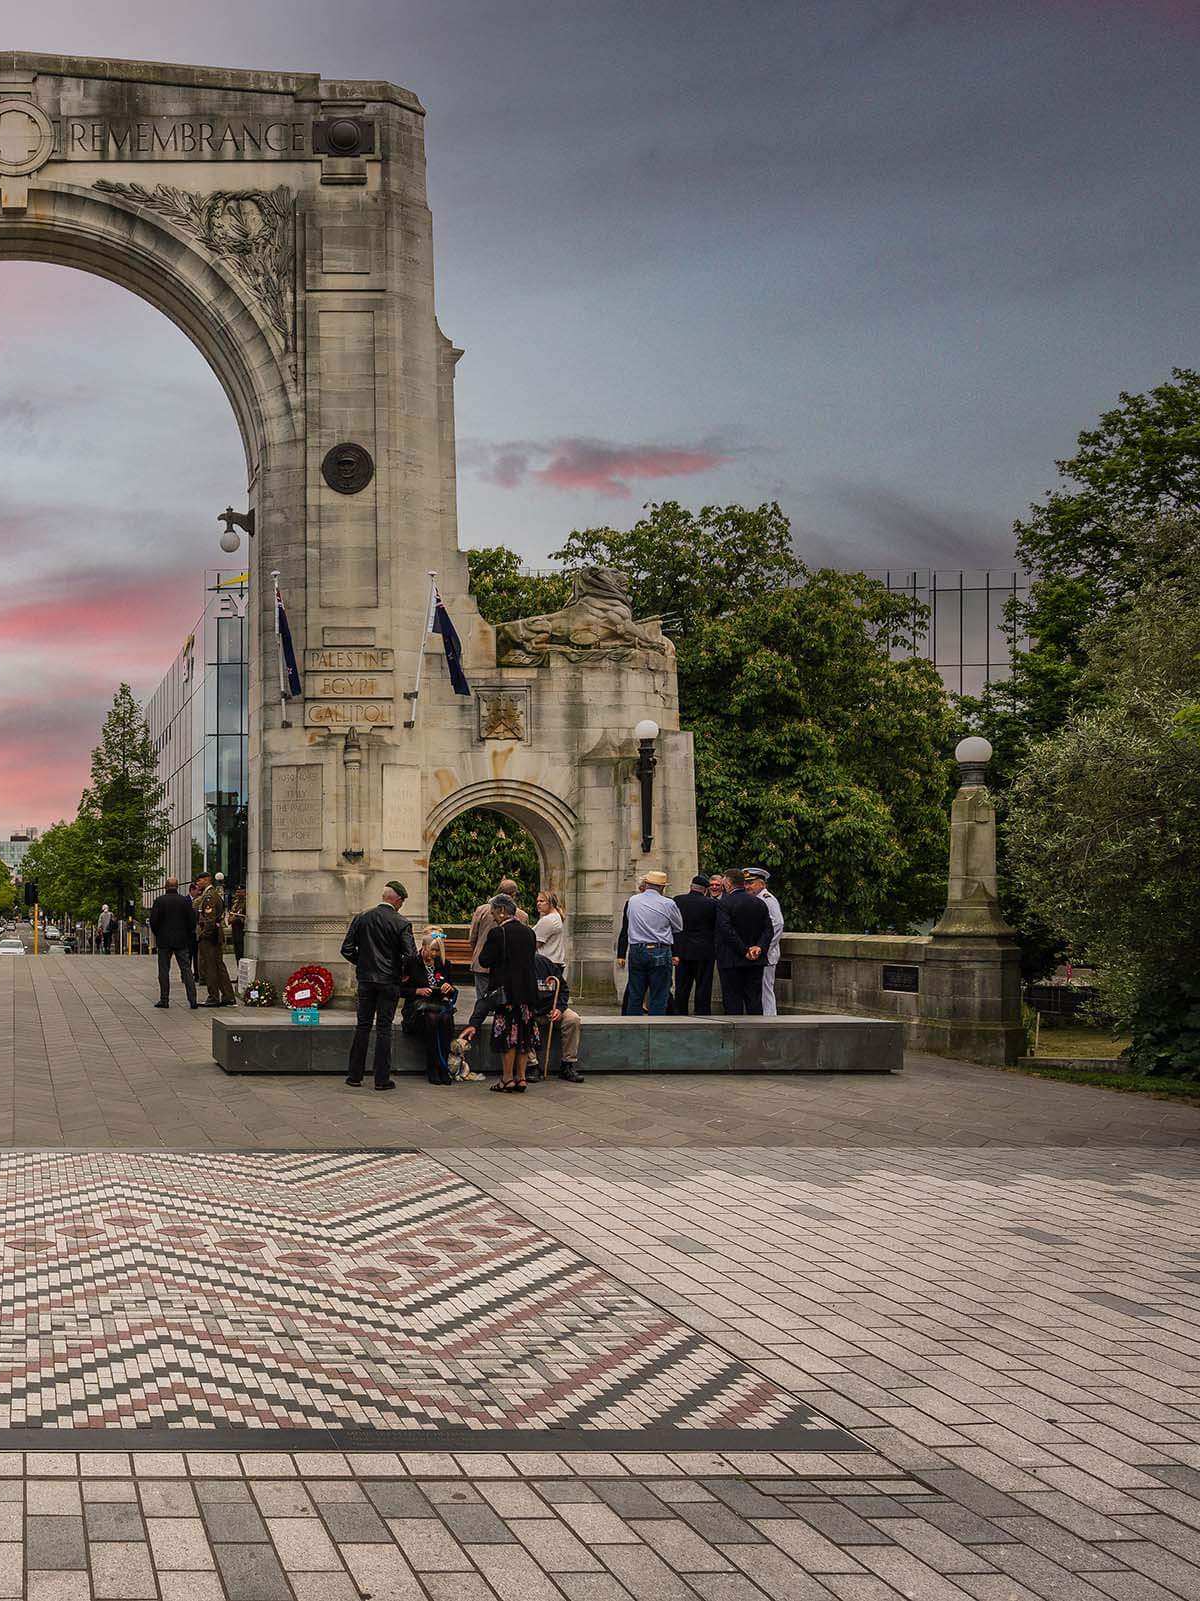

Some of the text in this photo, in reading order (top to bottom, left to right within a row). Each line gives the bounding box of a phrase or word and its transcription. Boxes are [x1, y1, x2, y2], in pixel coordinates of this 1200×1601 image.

[71, 122, 305, 153] REMEMBRANCE
[217, 594, 248, 618] EY
[311, 652, 388, 667] PALESTINE
[323, 678, 377, 695] EGYPT
[308, 705, 391, 722] GALLIPOLI
